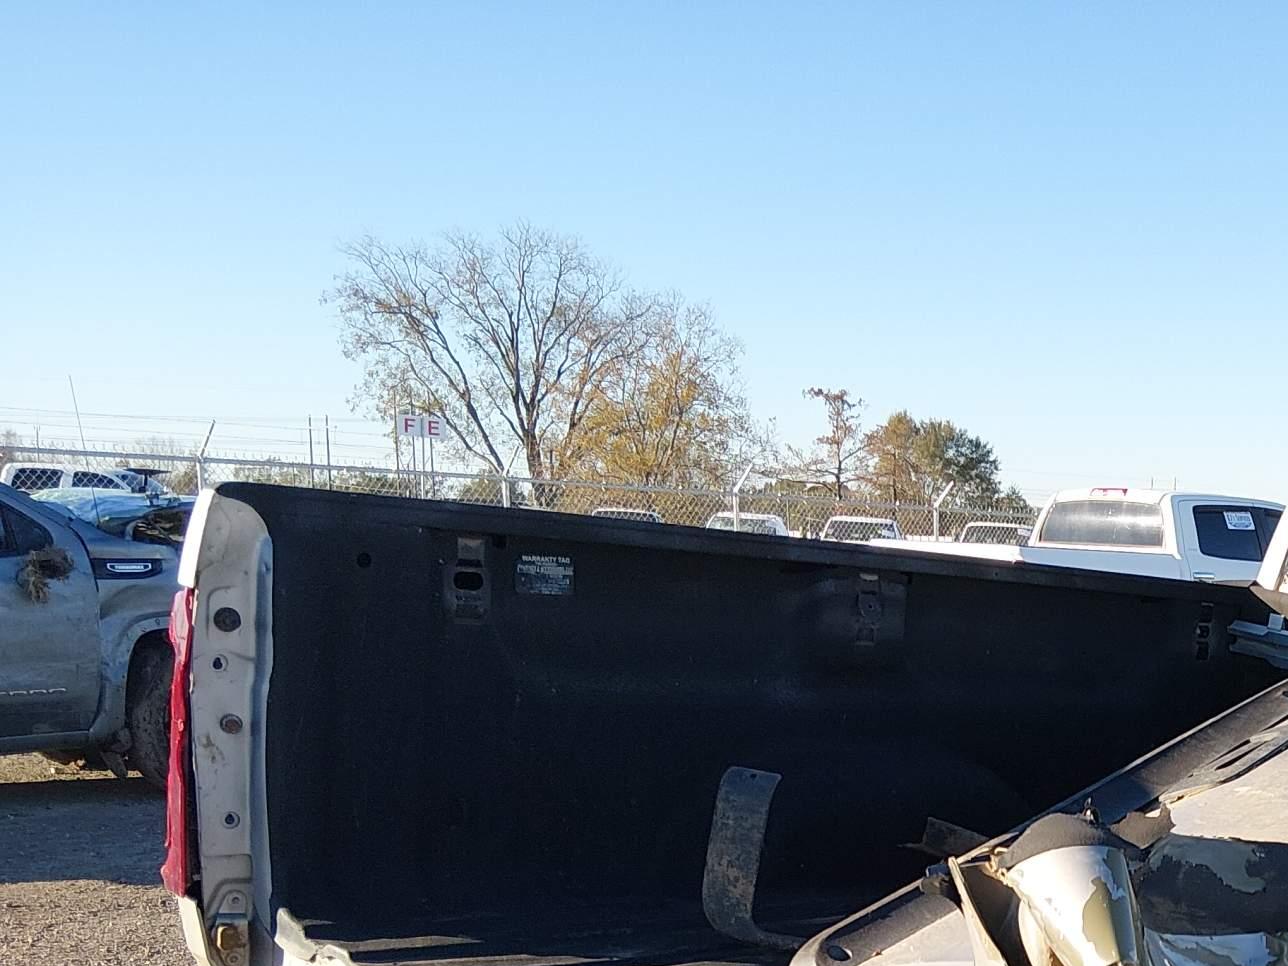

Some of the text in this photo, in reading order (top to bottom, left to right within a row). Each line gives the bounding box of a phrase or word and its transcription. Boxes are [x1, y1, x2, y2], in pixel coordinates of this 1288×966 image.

[404, 418, 416, 433] F
[428, 420, 440, 436] E
[521, 555, 557, 563] WARRANTY
[557, 556, 571, 564] TAG
